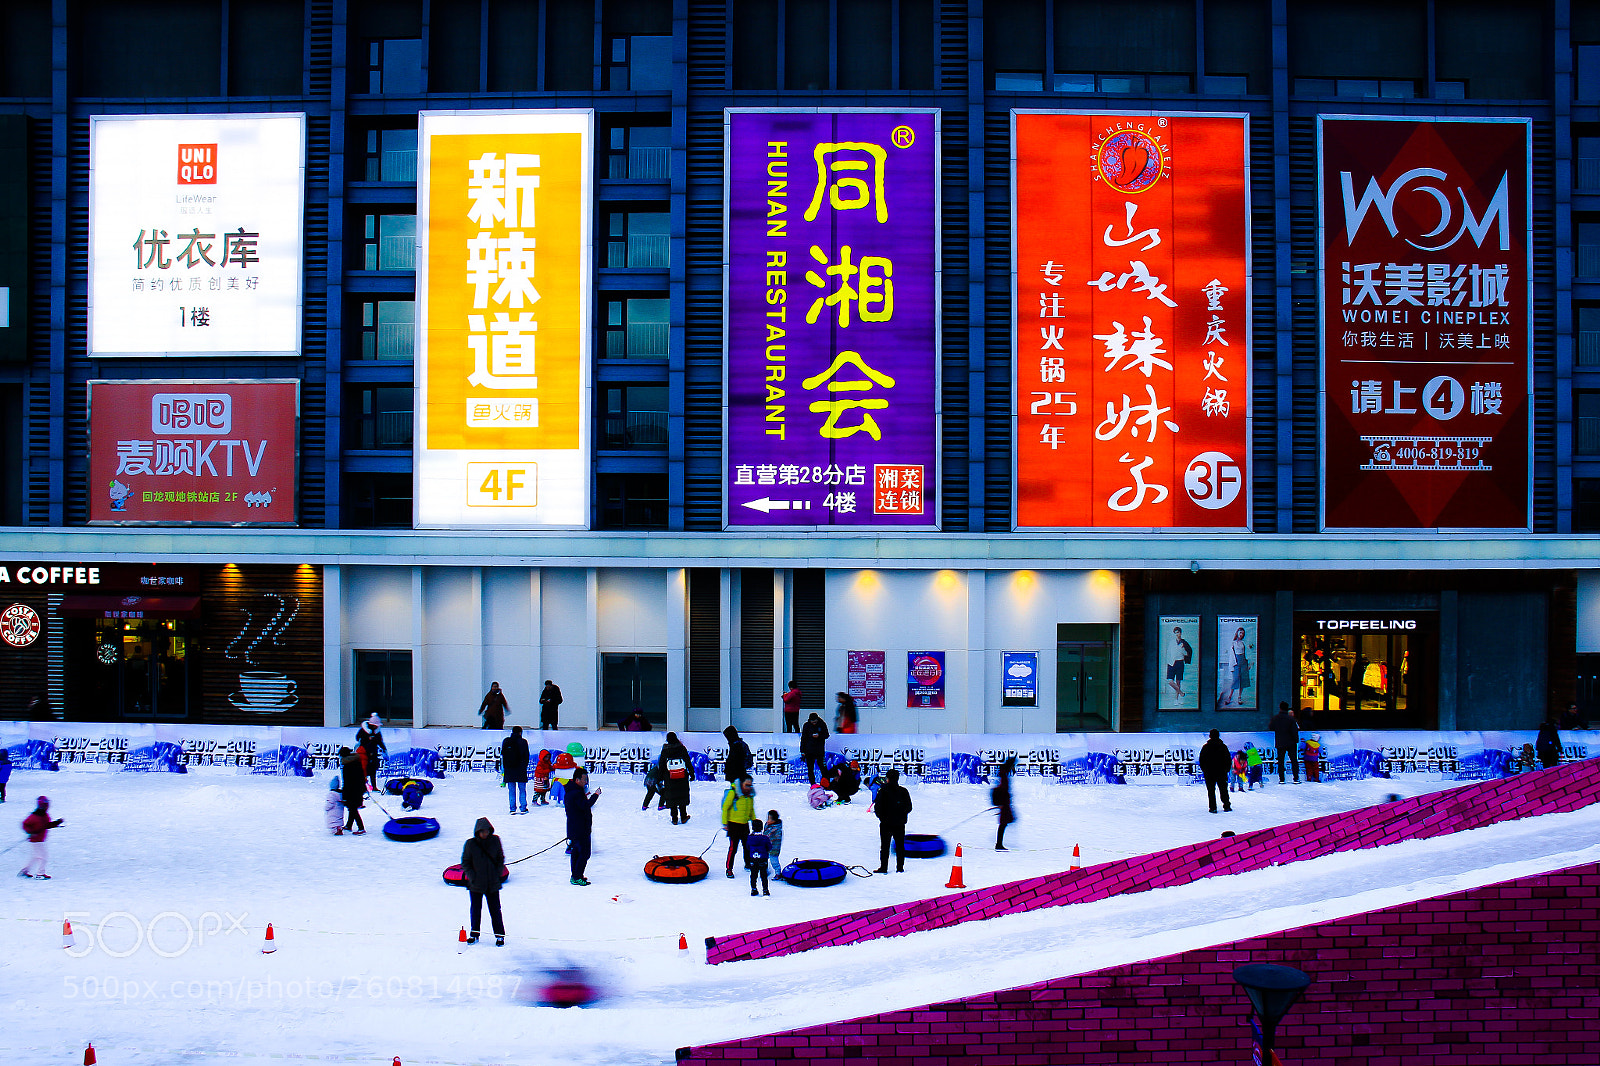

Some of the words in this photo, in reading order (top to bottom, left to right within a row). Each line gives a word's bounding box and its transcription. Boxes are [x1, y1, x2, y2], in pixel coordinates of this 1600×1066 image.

[181, 148, 211, 163] UNI
[181, 165, 214, 183] QLO
[176, 194, 217, 204] LifeWear
[766, 141, 788, 238] HUNAN
[1340, 167, 1511, 251] WOM
[132, 227, 260, 270] 优衣库
[466, 152, 542, 390] 新辣道
[132, 276, 260, 292] 简约优质创美好
[801, 141, 896, 442] 同湘会
[1342, 261, 1510, 308] 沃美影城
[179, 306, 211, 328] 1楼
[1342, 309, 1409, 324] WOMEI
[1420, 310, 1510, 326] CINEPLEX
[765, 250, 788, 441] RESTAURANT
[1201, 278, 1230, 419] 重庆火锅
[1341, 331, 1414, 349] 你我生活
[1439, 332, 1511, 350] 沃美上映
[1086, 201, 1180, 512] 山城辣妹子
[159, 398, 225, 429] 唱吧
[472, 403, 532, 422] 鱼火锅
[1395, 446, 1480, 462] 4006-819-819
[479, 469, 527, 502] 4F
[734, 463, 867, 486] 直营第28分店
[878, 467, 921, 489] 湘菜
[1188, 460, 1238, 502] 3F
[142, 491, 220, 503] 回龙观地铁站店
[224, 491, 239, 502] 2F
[822, 492, 857, 514] 4楼
[878, 489, 921, 512] 连锁
[16, 566, 101, 585] COFFEE
[5, 606, 35, 620] COSTA
[1316, 620, 1417, 630] TOPFEELING
[4, 629, 38, 645] COFFEE
